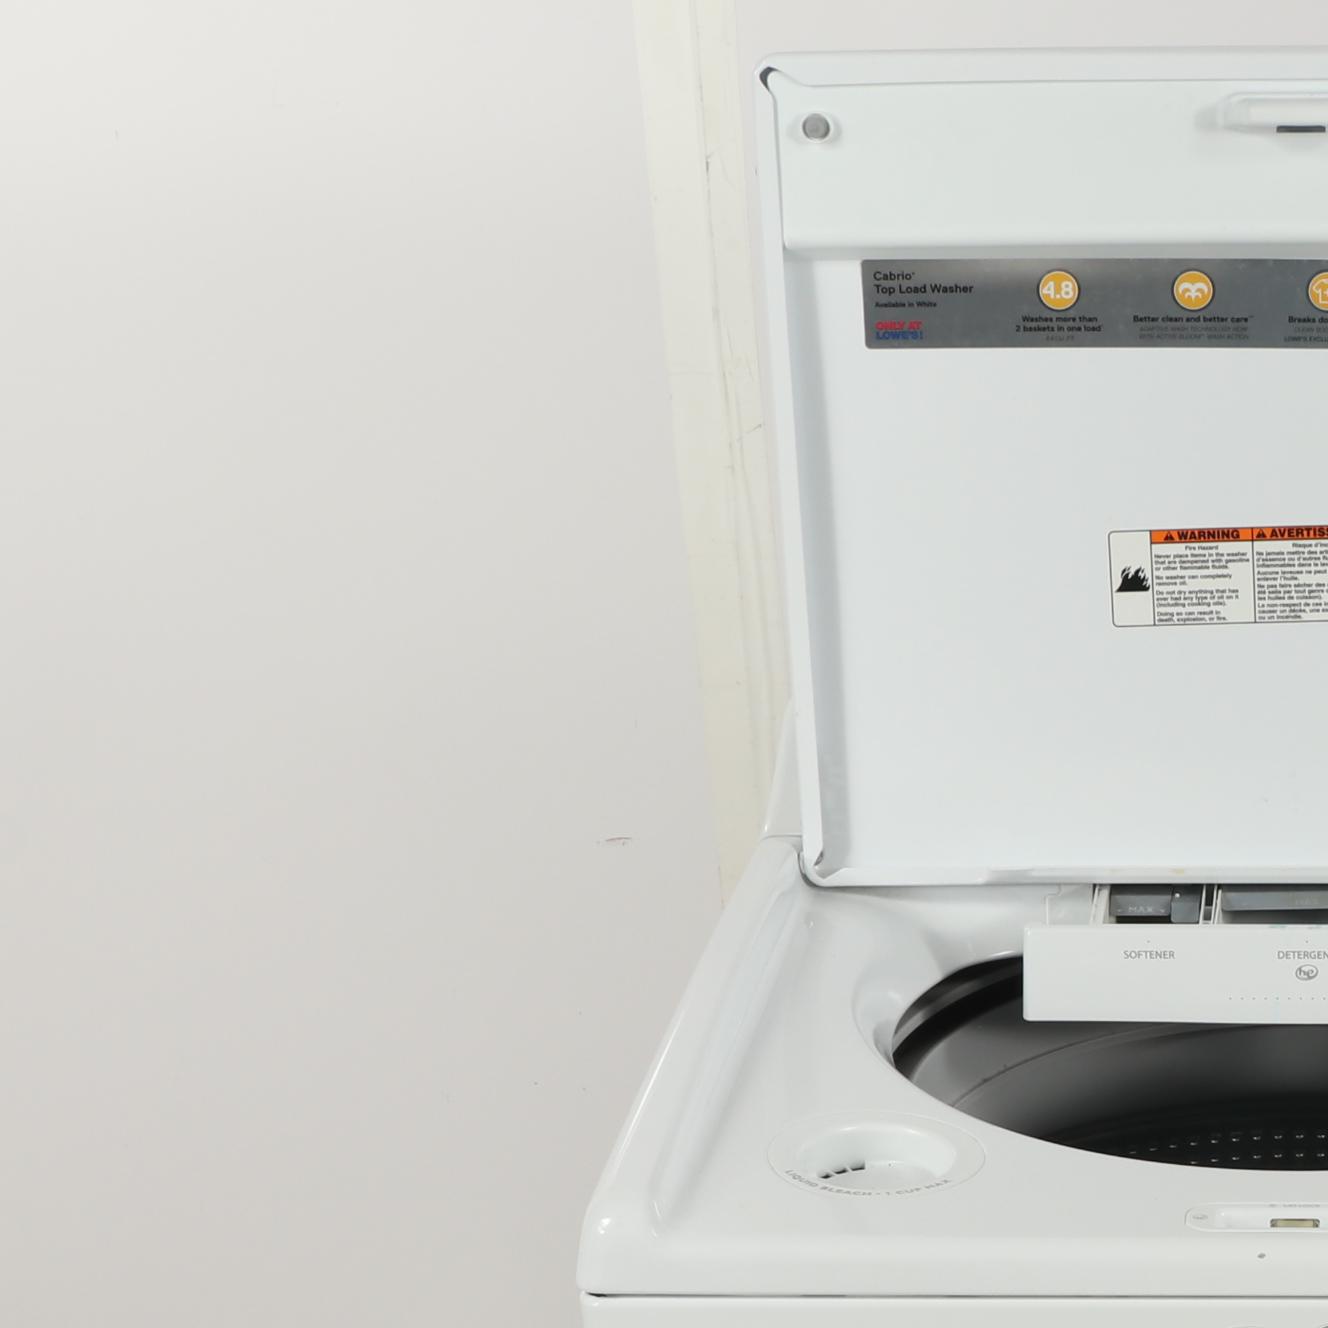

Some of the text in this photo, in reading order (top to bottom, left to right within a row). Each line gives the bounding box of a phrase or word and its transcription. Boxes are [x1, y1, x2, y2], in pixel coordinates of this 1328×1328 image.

[875, 284, 974, 295] Top Load Washer
[1042, 281, 1074, 299] 4.8
[1078, 315, 1098, 323] than
[1133, 315, 1159, 323] Better
[1162, 315, 1183, 323] clean
[1185, 315, 1201, 323] and
[1203, 315, 1228, 323] better
[1288, 316, 1315, 324] Breaks
[1177, 530, 1240, 540] WARNING
[1123, 950, 1175, 960] SOFTENER
[785, 1169, 818, 1188] LIQUID
[820, 1186, 872, 1196] BLEACH
[925, 1179, 952, 1189] MAX
